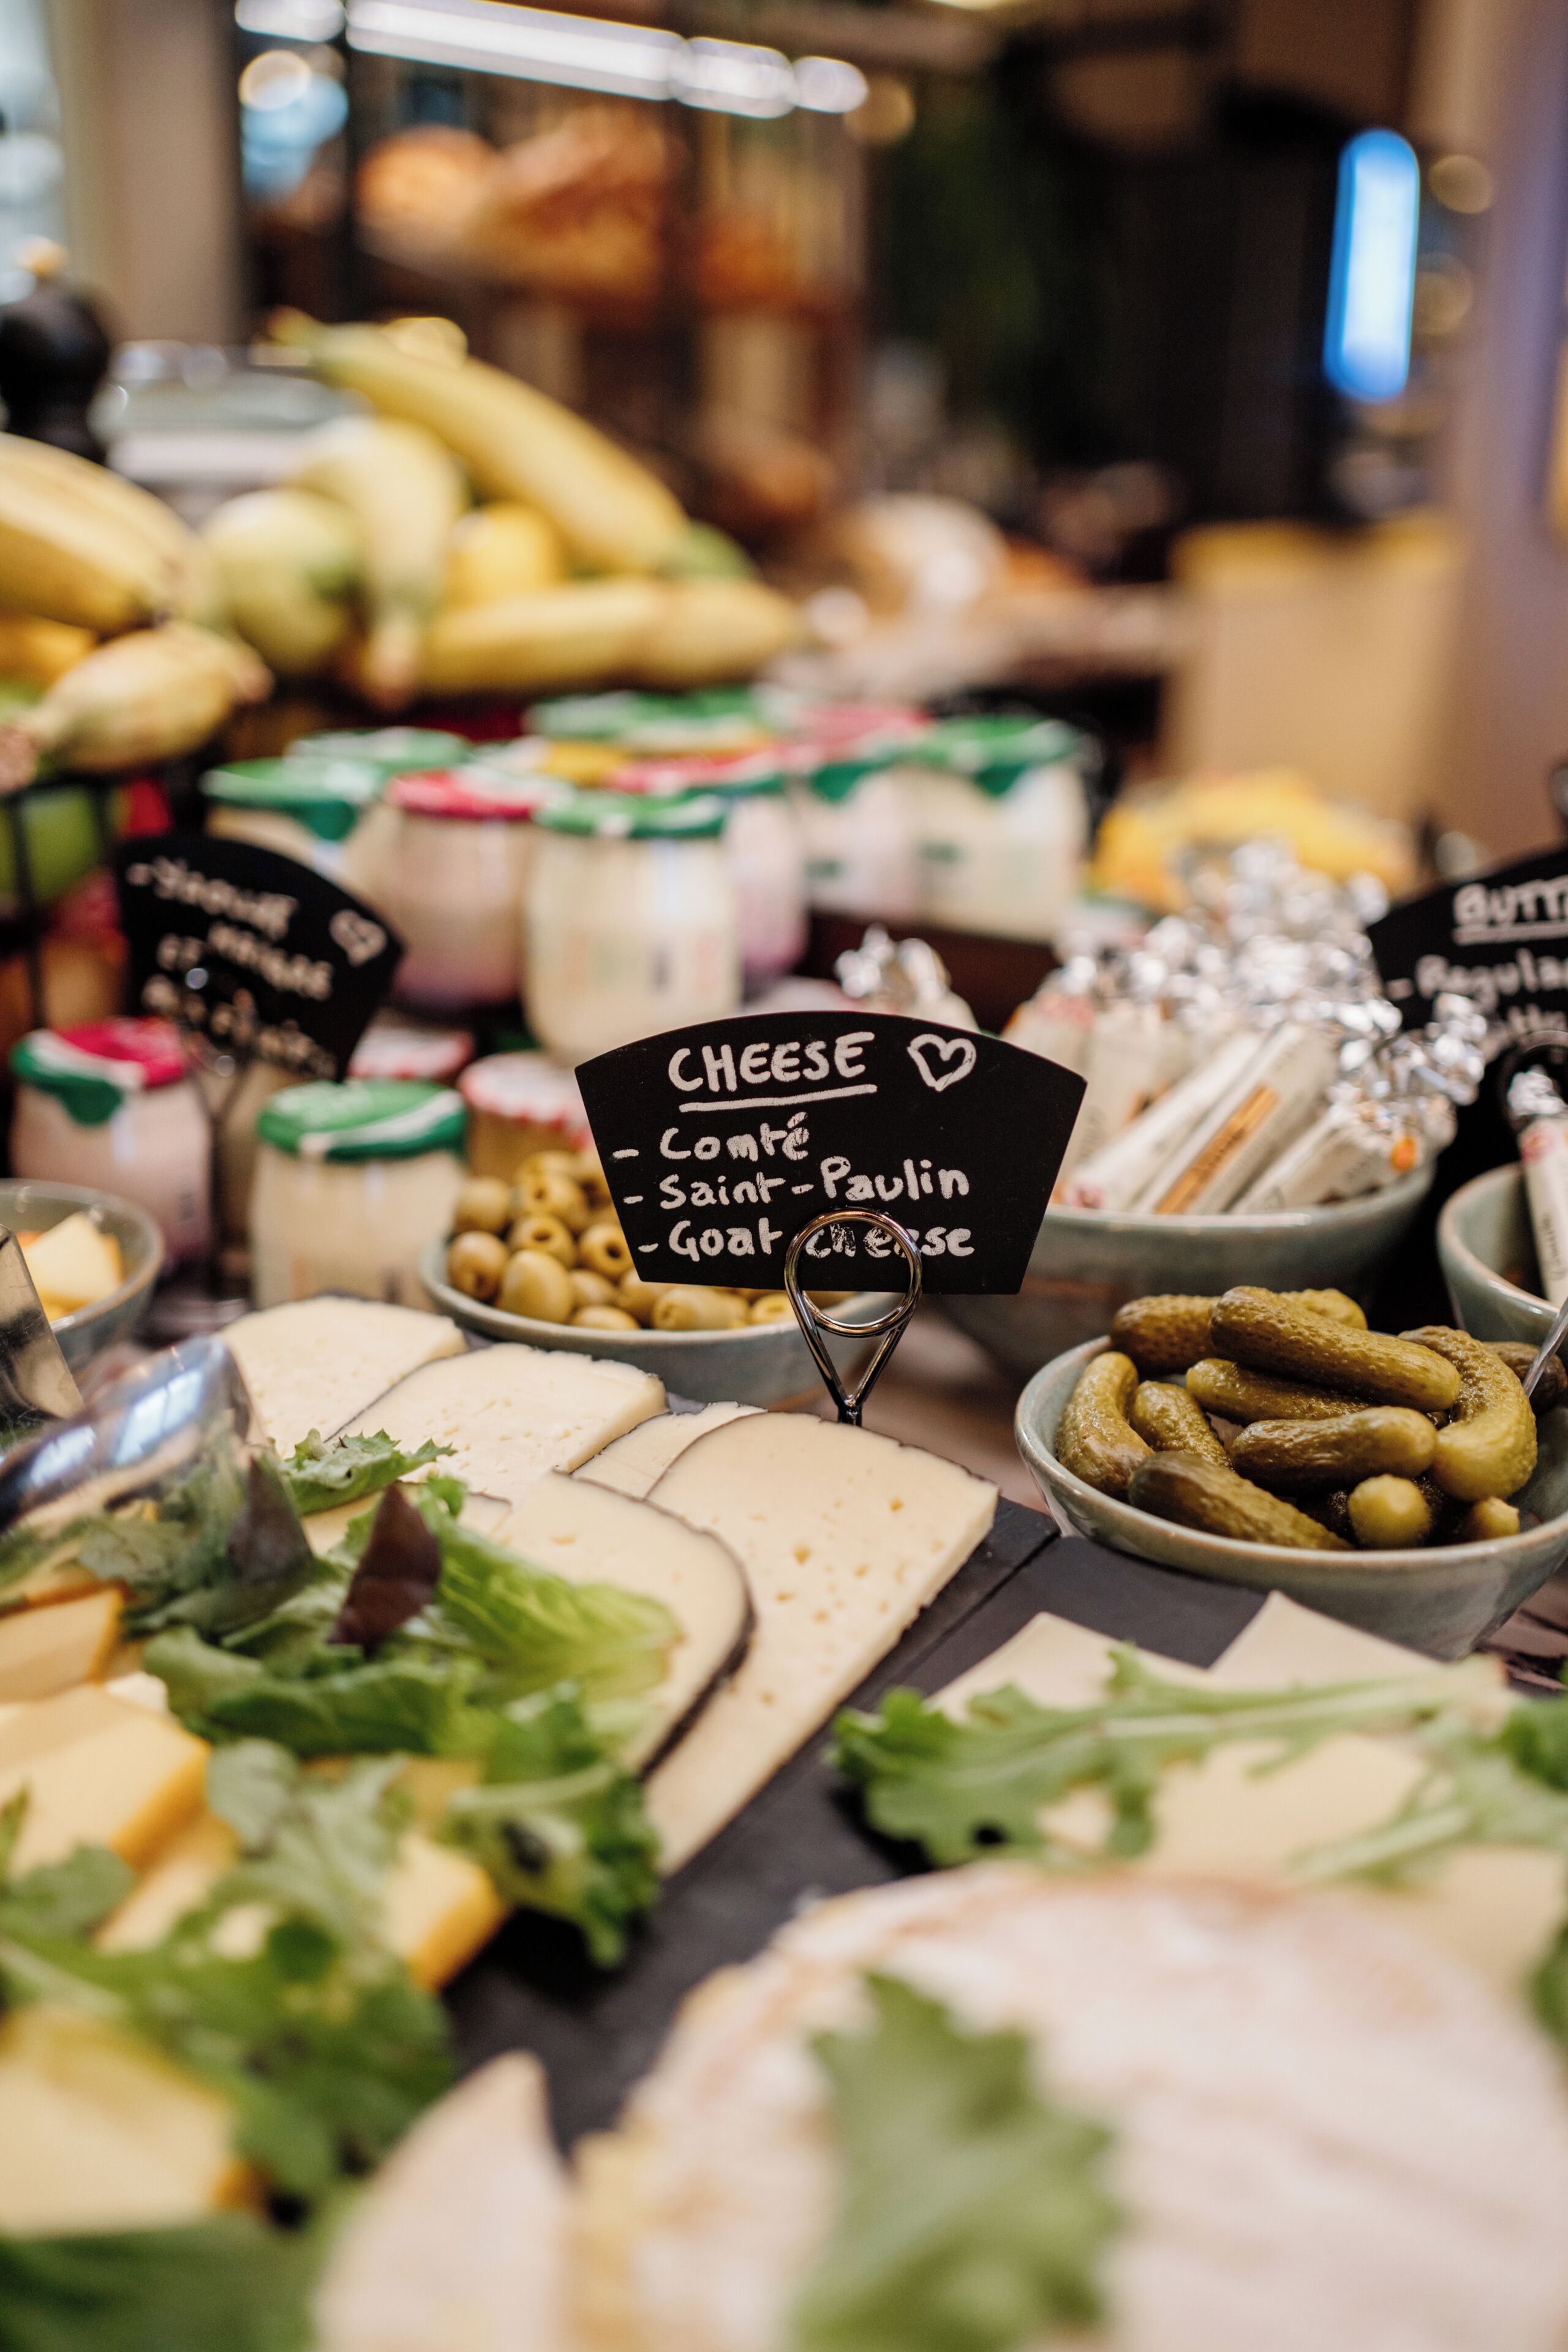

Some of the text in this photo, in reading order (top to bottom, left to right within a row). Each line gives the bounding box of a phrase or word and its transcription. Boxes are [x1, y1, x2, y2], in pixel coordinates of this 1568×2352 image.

[1453, 875, 1568, 924] BUTT
[1415, 948, 1568, 1014] Regula
[669, 1032, 875, 1091] CHEESE
[660, 1112, 809, 1161] Comté
[660, 1156, 969, 1209] Saint-Paulin
[669, 1218, 783, 1262] Goat
